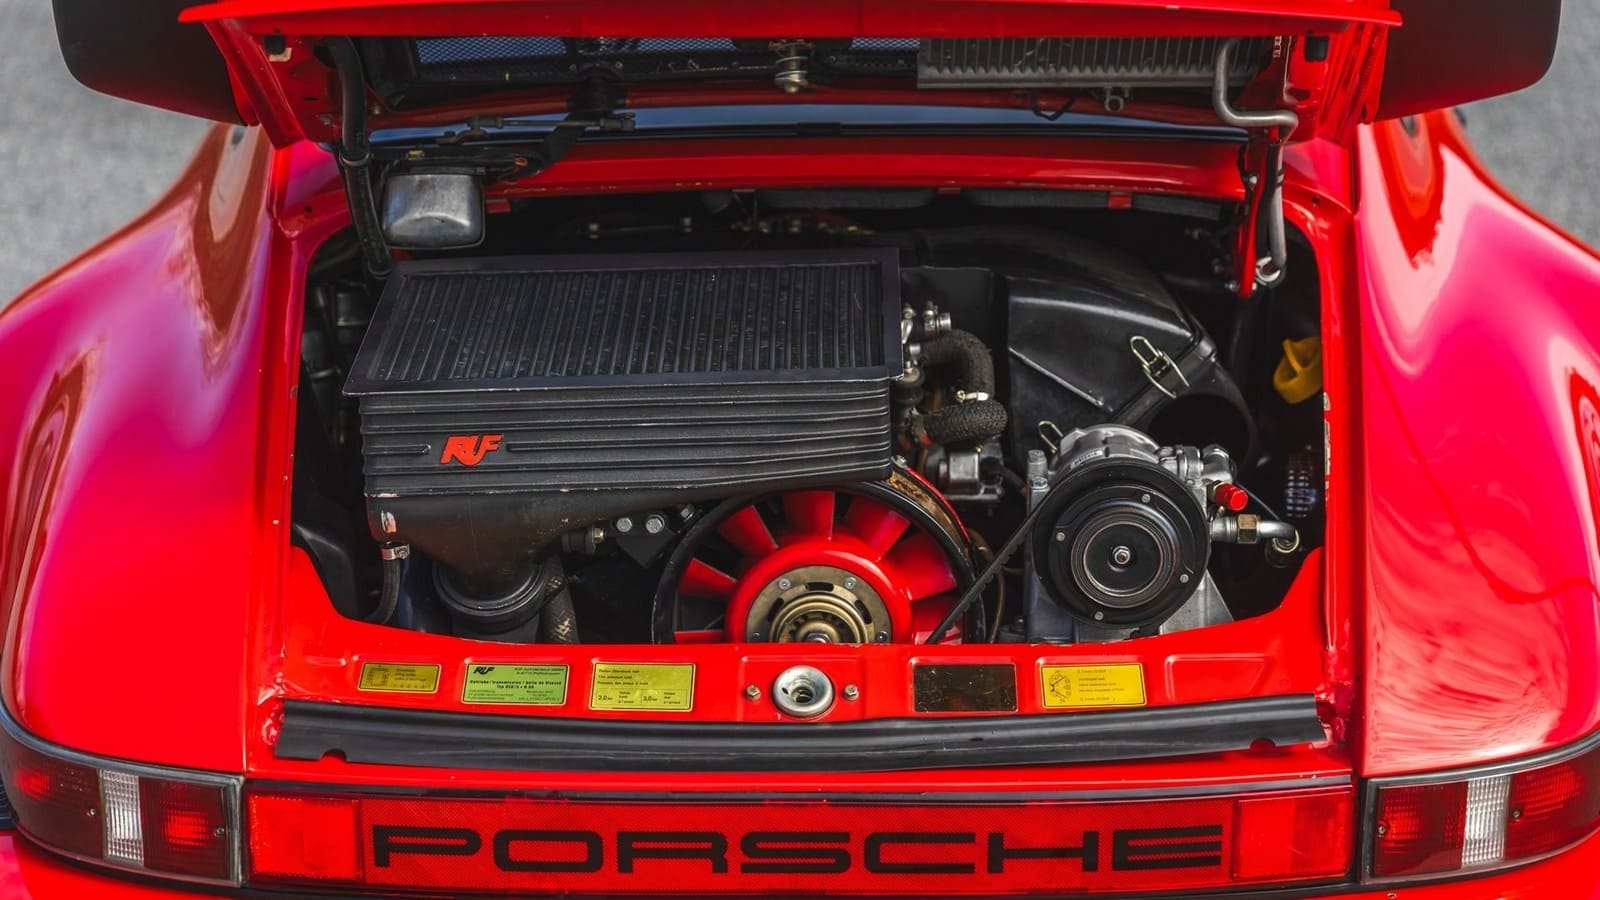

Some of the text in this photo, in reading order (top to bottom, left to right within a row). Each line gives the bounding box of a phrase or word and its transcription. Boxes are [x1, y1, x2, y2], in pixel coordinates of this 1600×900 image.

[440, 434, 503, 466] RUF
[473, 666, 495, 675] RUF
[373, 825, 1222, 874] PORSCHE
